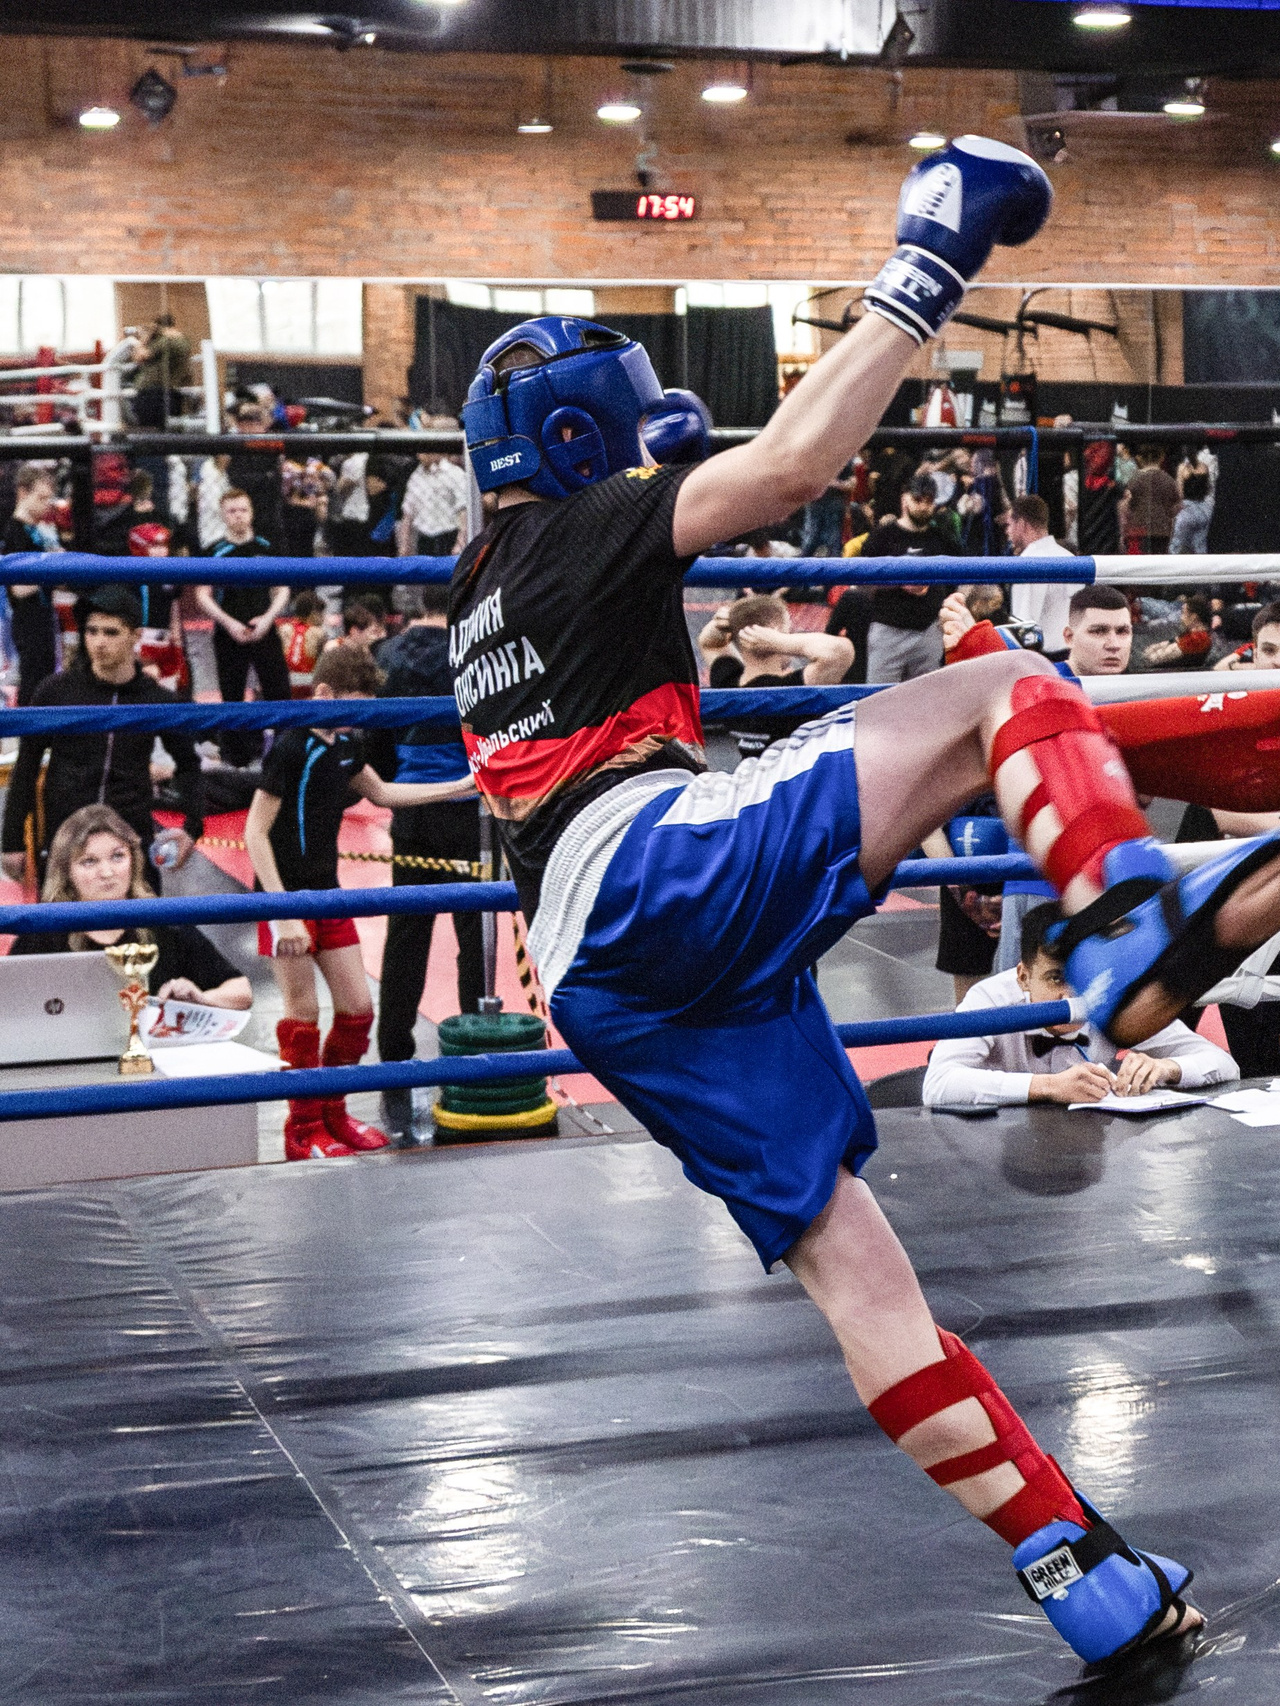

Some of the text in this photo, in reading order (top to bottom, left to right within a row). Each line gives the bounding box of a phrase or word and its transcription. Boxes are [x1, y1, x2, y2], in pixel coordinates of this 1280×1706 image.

[637, 194, 696, 219] 17:54
[490, 451, 522, 472] BEST
[1031, 1553, 1072, 1583] GREEN
[1043, 1570, 1068, 1590] HILL
